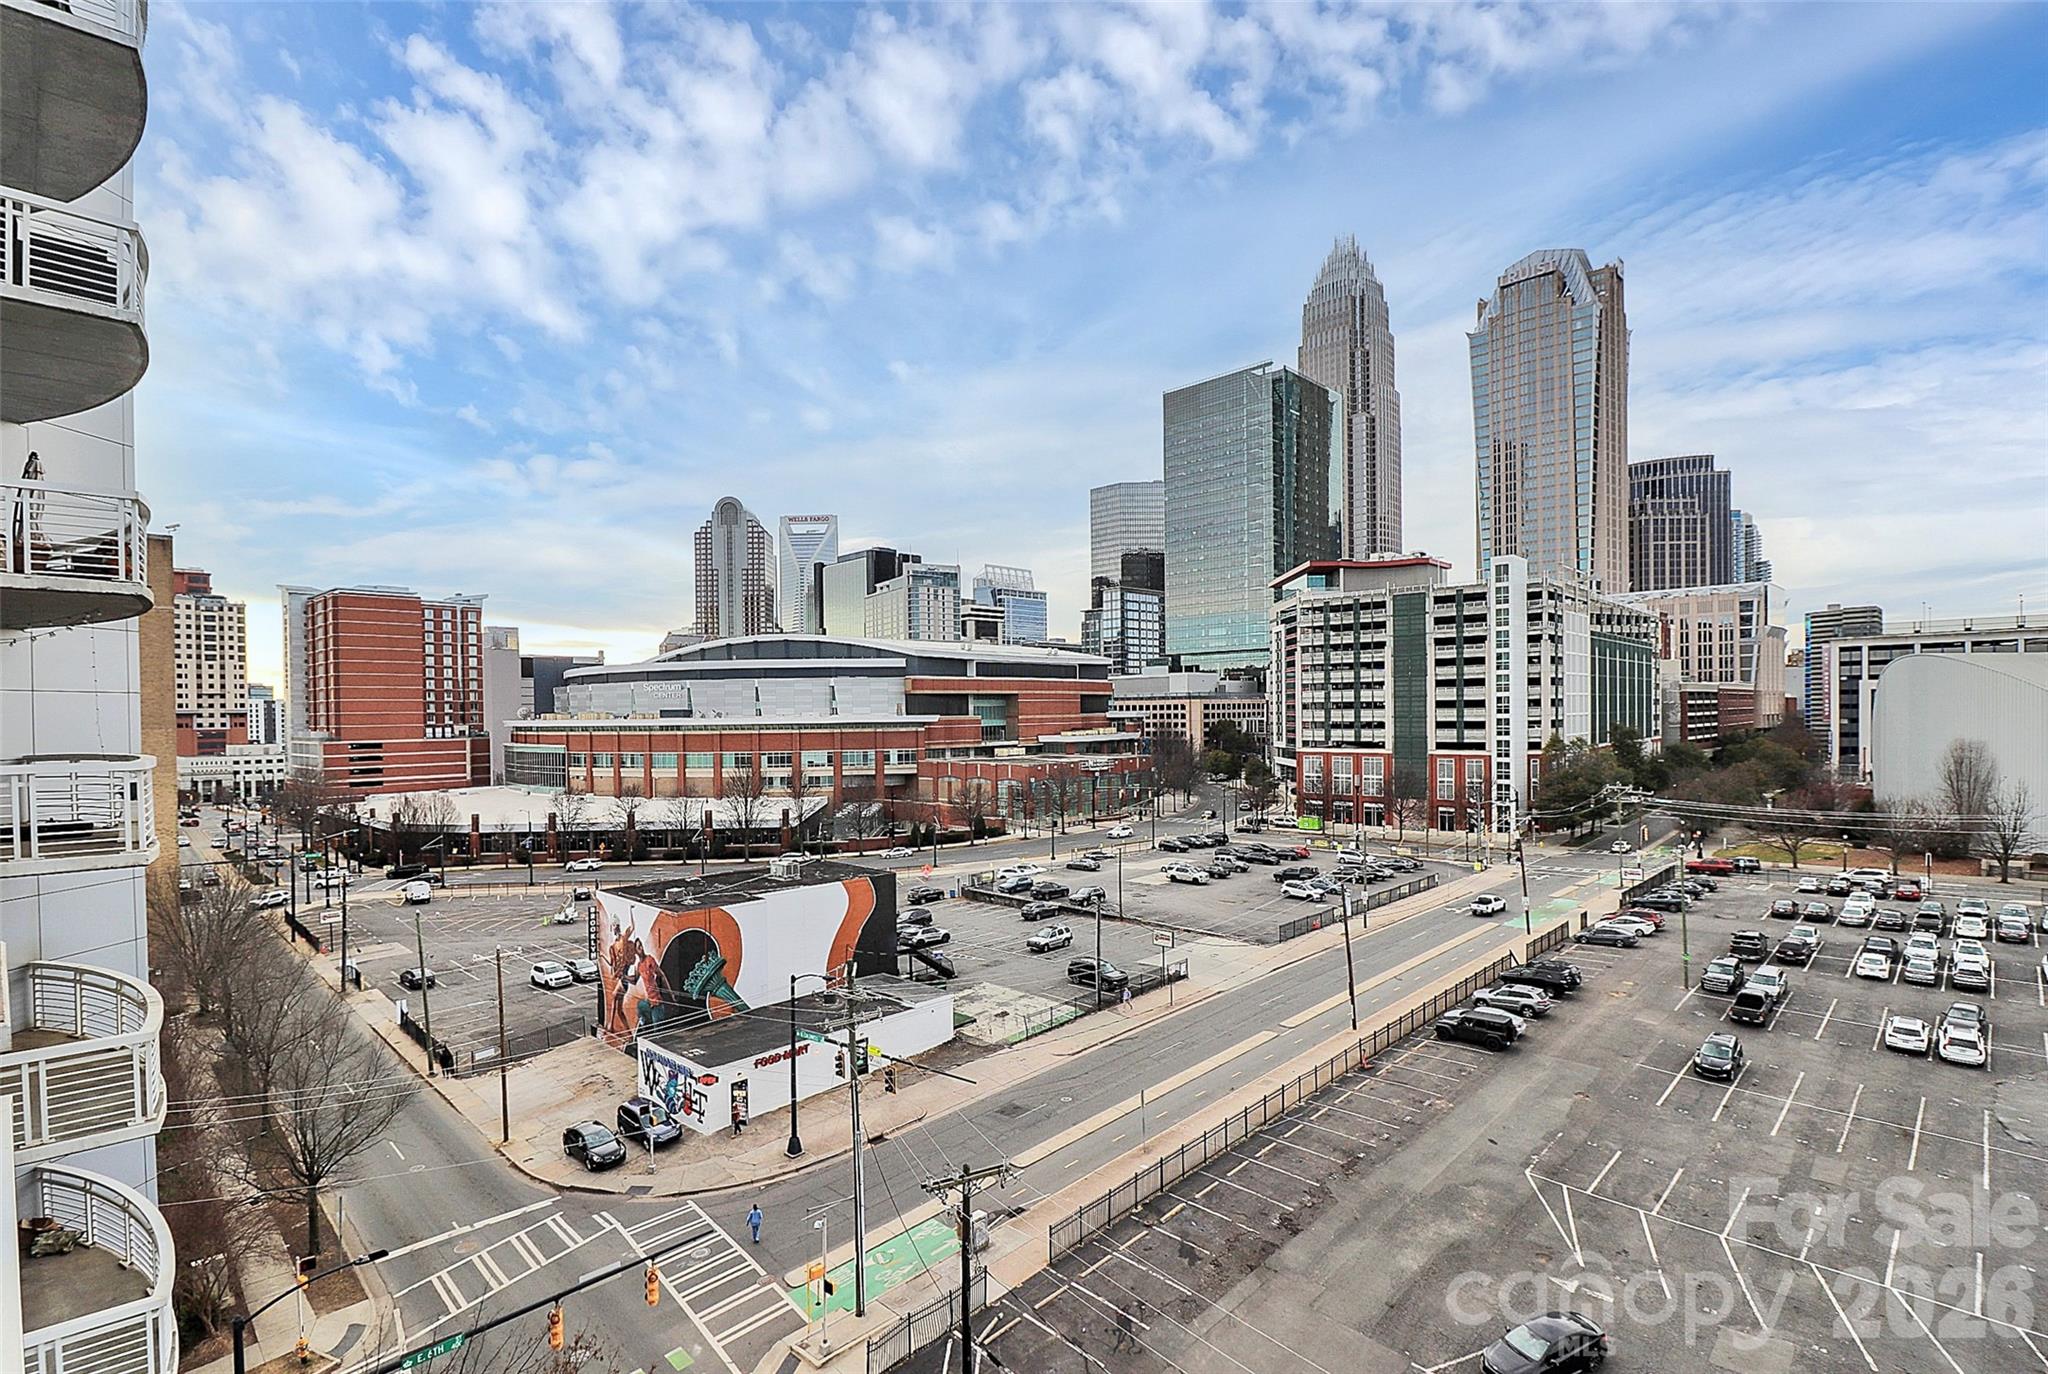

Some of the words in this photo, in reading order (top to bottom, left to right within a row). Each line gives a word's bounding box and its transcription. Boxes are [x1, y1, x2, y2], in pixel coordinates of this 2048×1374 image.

[643, 682, 682, 693] Spectrum
[754, 1052, 782, 1069] FOOD
[427, 1344, 445, 1359] 6TH
